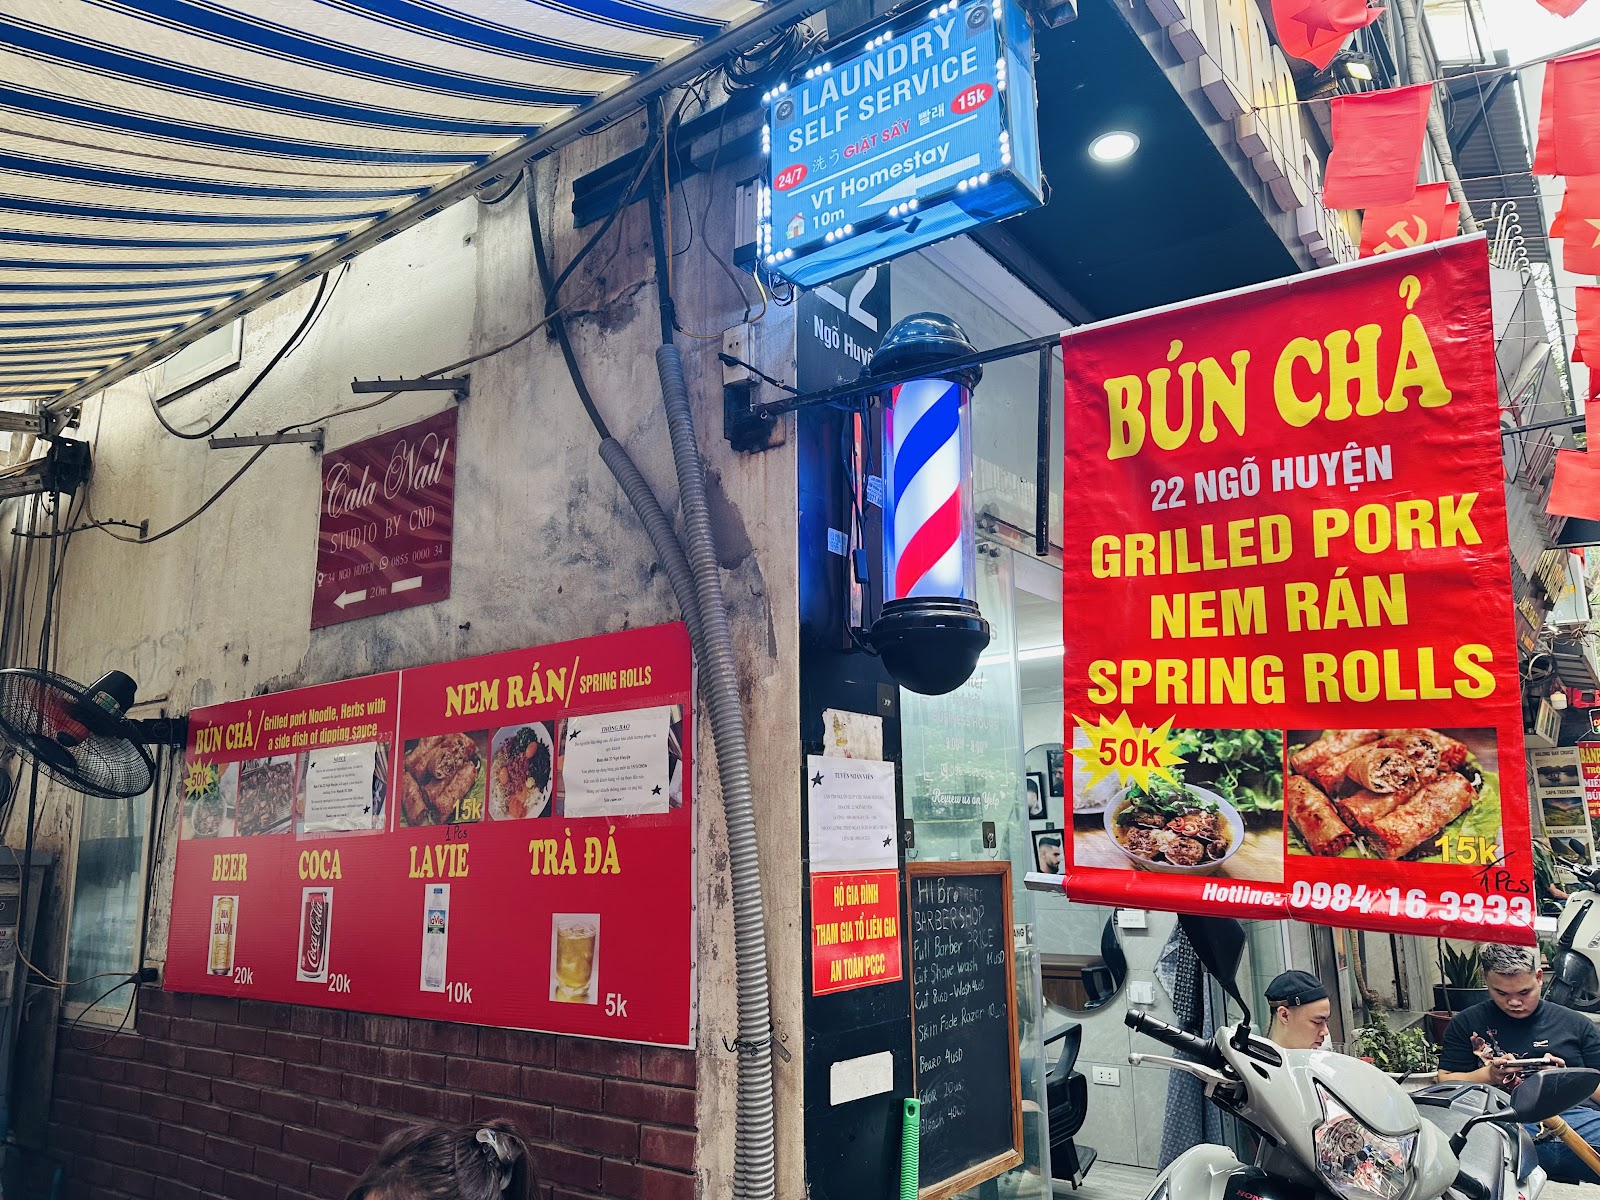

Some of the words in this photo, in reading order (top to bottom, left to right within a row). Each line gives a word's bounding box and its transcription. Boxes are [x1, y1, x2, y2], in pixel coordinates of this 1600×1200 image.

[802, 17, 956, 116] LAUNDRY
[788, 109, 850, 153] SELF
[858, 46, 978, 121] SERVICE
[957, 87, 986, 111] 15k
[778, 162, 804, 187] 24/7
[811, 183, 836, 211] VT
[841, 141, 951, 197] Homestay
[812, 207, 846, 231] 10m
[813, 314, 840, 350] Ngõ
[843, 332, 874, 366] Huyê
[1103, 339, 1251, 461] BÚN
[1273, 274, 1453, 428] CHẢ
[326, 462, 378, 519] Cala
[384, 432, 450, 500] Nail
[1150, 478, 1186, 511] 22
[1194, 455, 1261, 505] NGÕ
[1272, 442, 1393, 493] HUYỆN
[330, 522, 377, 554] STUDIO
[384, 515, 401, 540] BY
[409, 505, 435, 531] CND
[1091, 514, 1293, 579] GRILLED
[1313, 492, 1483, 558] PORK
[412, 548, 430, 563] 0000
[327, 571, 336, 583] 34
[369, 586, 387, 599] 20m
[1150, 585, 1267, 640] NEM
[1285, 567, 1409, 634] RÁN
[579, 671, 617, 694] SPRING
[619, 665, 652, 687] ROLLS
[1087, 655, 1286, 705] SPRING
[1304, 644, 1497, 704] ROLLS
[444, 678, 500, 718] NEM
[264, 715, 289, 732] Grilled
[290, 712, 307, 732] pork
[341, 702, 365, 719] Herbs
[367, 697, 386, 715] with
[195, 720, 224, 755] BÚN
[268, 739, 273, 751] a
[274, 733, 290, 749] side
[292, 731, 308, 747] dish
[310, 730, 319, 744] of
[319, 726, 350, 747] dipping
[352, 722, 378, 739] sauce
[1099, 737, 1161, 768] 50k
[191, 772, 208, 788] 50k
[453, 798, 483, 821] 15k
[931, 788, 961, 804] Review
[962, 795, 970, 804] us
[971, 795, 981, 805] on
[982, 791, 1000, 810] Yelp
[298, 849, 343, 880] COCA
[408, 843, 470, 879] LAVIE
[528, 827, 577, 876] TRÀ
[583, 825, 621, 875] ĐÁ
[1434, 835, 1501, 866] 15k
[212, 853, 248, 882] BEER
[833, 884, 845, 911] HỘ
[845, 886, 859, 906] GIA
[860, 881, 879, 905] ĐÌNH
[1201, 882, 1284, 908] Hotline:
[1290, 880, 1373, 915] 0984
[1387, 887, 1427, 920] 16
[1438, 891, 1532, 928] 3333
[815, 924, 839, 947] THAM
[840, 921, 854, 944] GIA
[855, 908, 866, 943] TỔ
[866, 915, 884, 940] LIÊN
[884, 916, 897, 937] GIA
[914, 938, 930, 961] Full
[934, 934, 964, 958] Barber
[234, 966, 254, 985] 20k
[830, 959, 842, 982] AN
[842, 952, 864, 981] TOÀN
[865, 953, 886, 976] PCCC
[914, 966, 928, 986] Cut
[931, 962, 954, 985] Shave
[328, 973, 351, 993] 20k
[446, 981, 472, 1004] 10k
[605, 993, 628, 1017] 5k
[914, 989, 929, 1010] Cut
[918, 1020, 938, 1042] Skin
